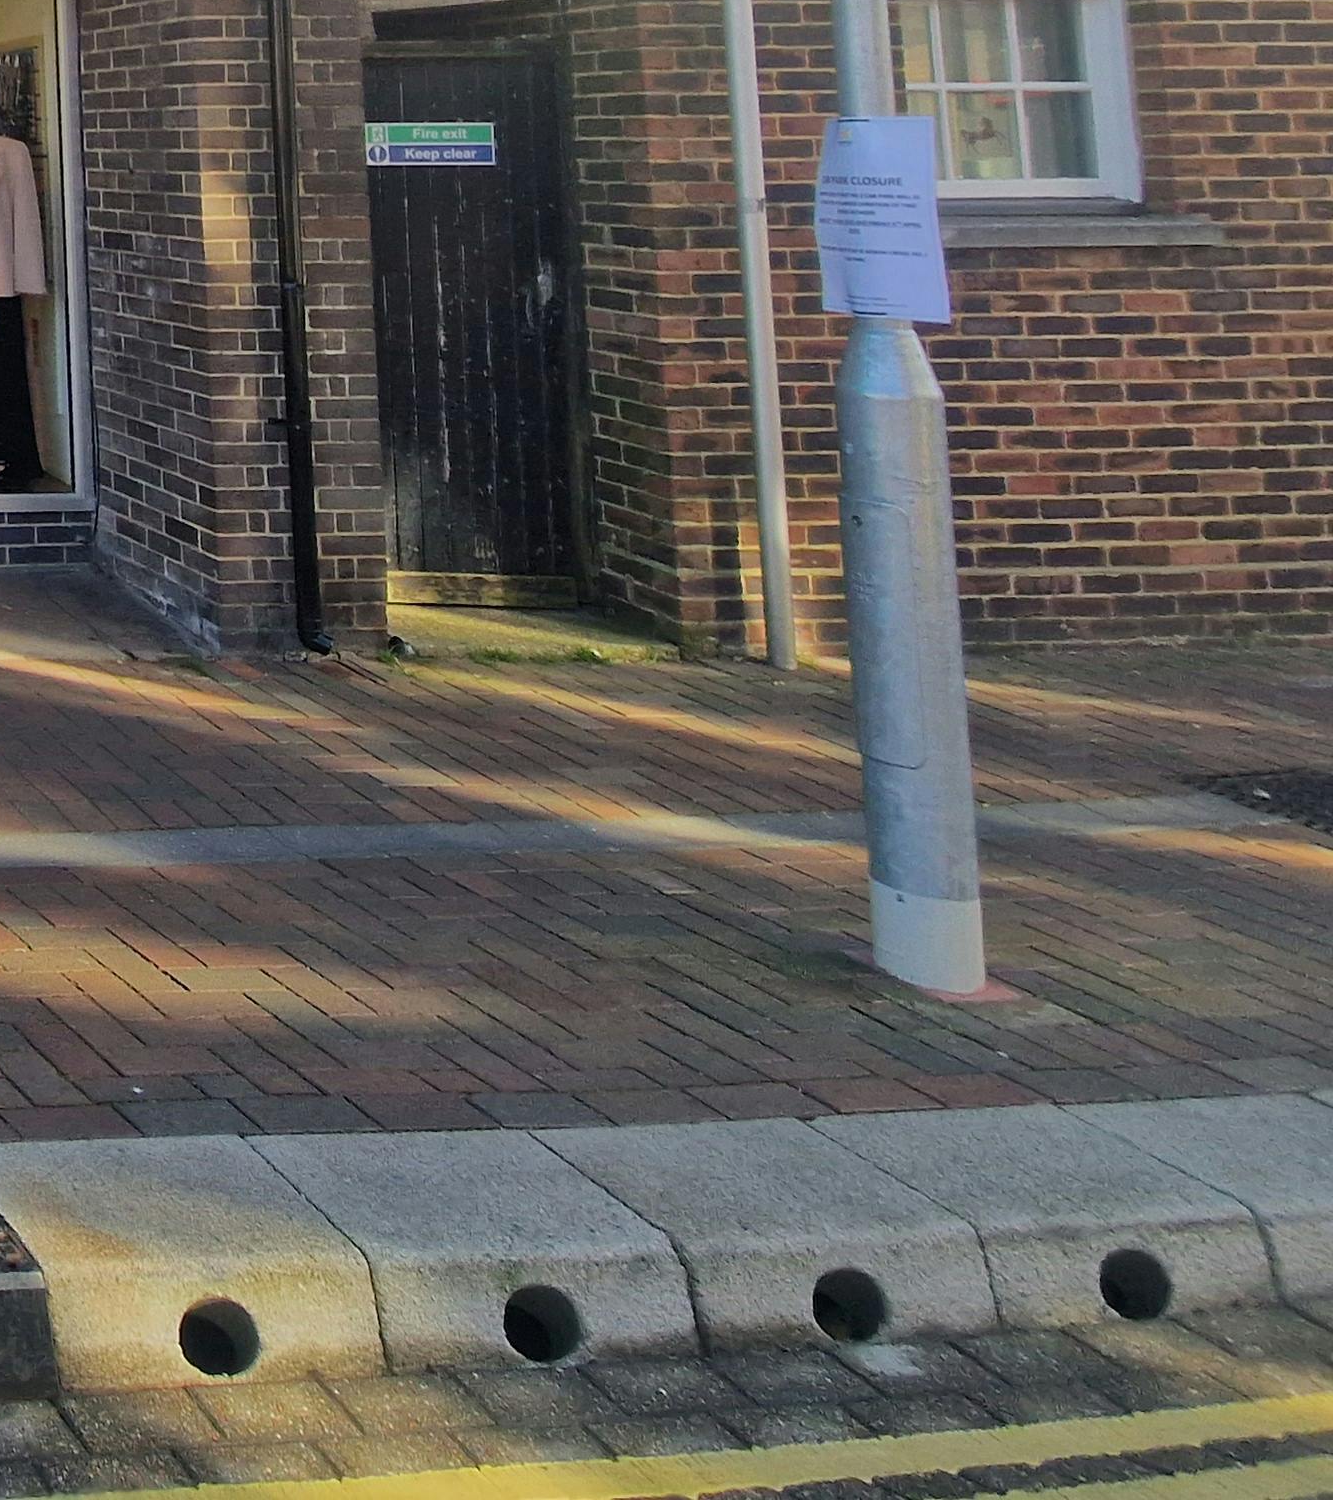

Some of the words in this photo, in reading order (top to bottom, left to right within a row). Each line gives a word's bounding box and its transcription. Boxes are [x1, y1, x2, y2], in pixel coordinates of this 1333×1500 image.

[412, 127, 438, 139] Fire
[442, 127, 467, 139] exit
[404, 148, 440, 161] Keep
[443, 147, 477, 160] clear
[850, 176, 903, 187] CLOSURE
